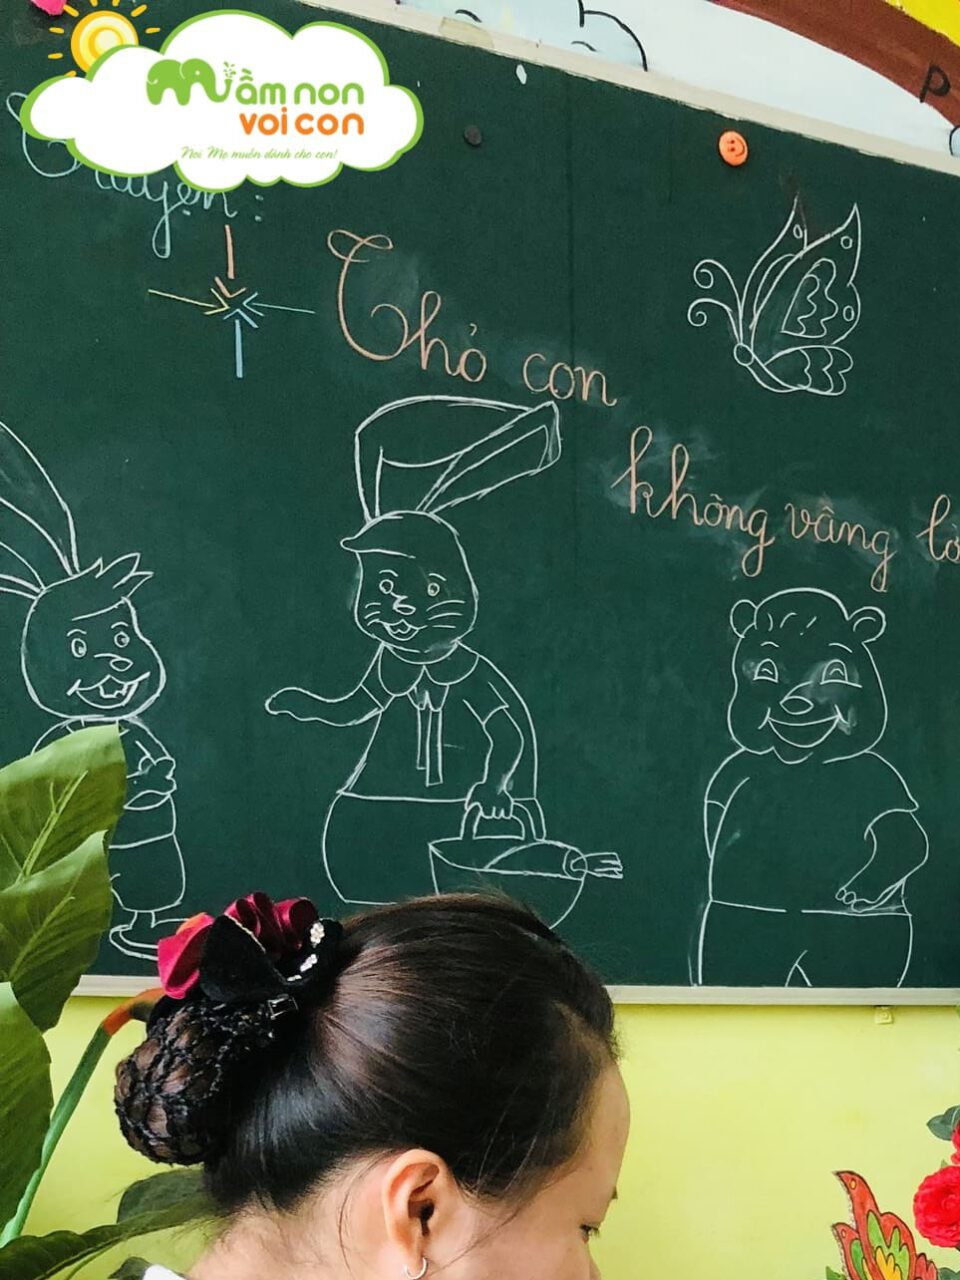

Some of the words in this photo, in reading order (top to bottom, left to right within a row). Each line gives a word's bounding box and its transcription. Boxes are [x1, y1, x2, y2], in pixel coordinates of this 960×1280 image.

[919, 63, 950, 103] P
[523, 352, 617, 407] con
[610, 425, 776, 577] không
[784, 502, 897, 593] vâng
